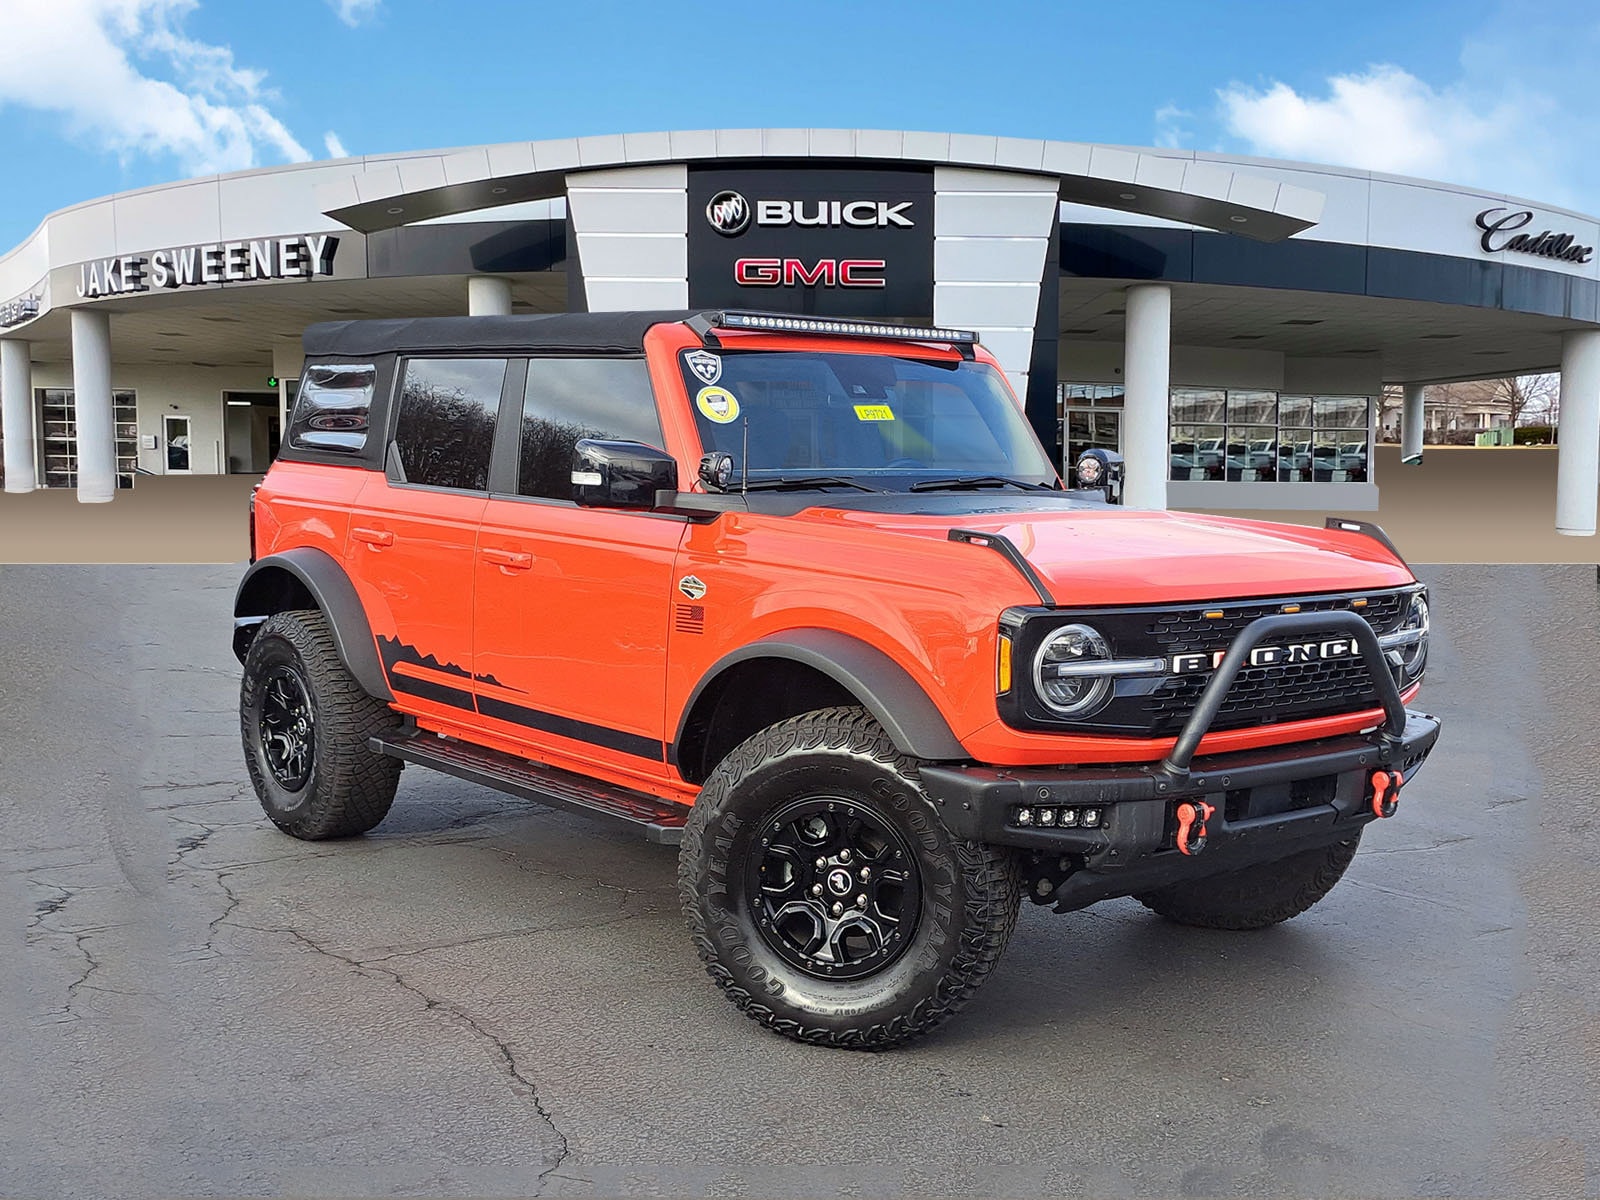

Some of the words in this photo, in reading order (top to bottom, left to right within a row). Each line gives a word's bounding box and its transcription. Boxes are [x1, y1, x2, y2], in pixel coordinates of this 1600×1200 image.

[757, 200, 914, 226] BUICK
[1475, 208, 1593, 263] Cadillac
[76, 256, 147, 298] JAKE
[151, 235, 338, 288] SWEENEY
[735, 258, 886, 287] GMC
[1173, 638, 1359, 673] BONC
